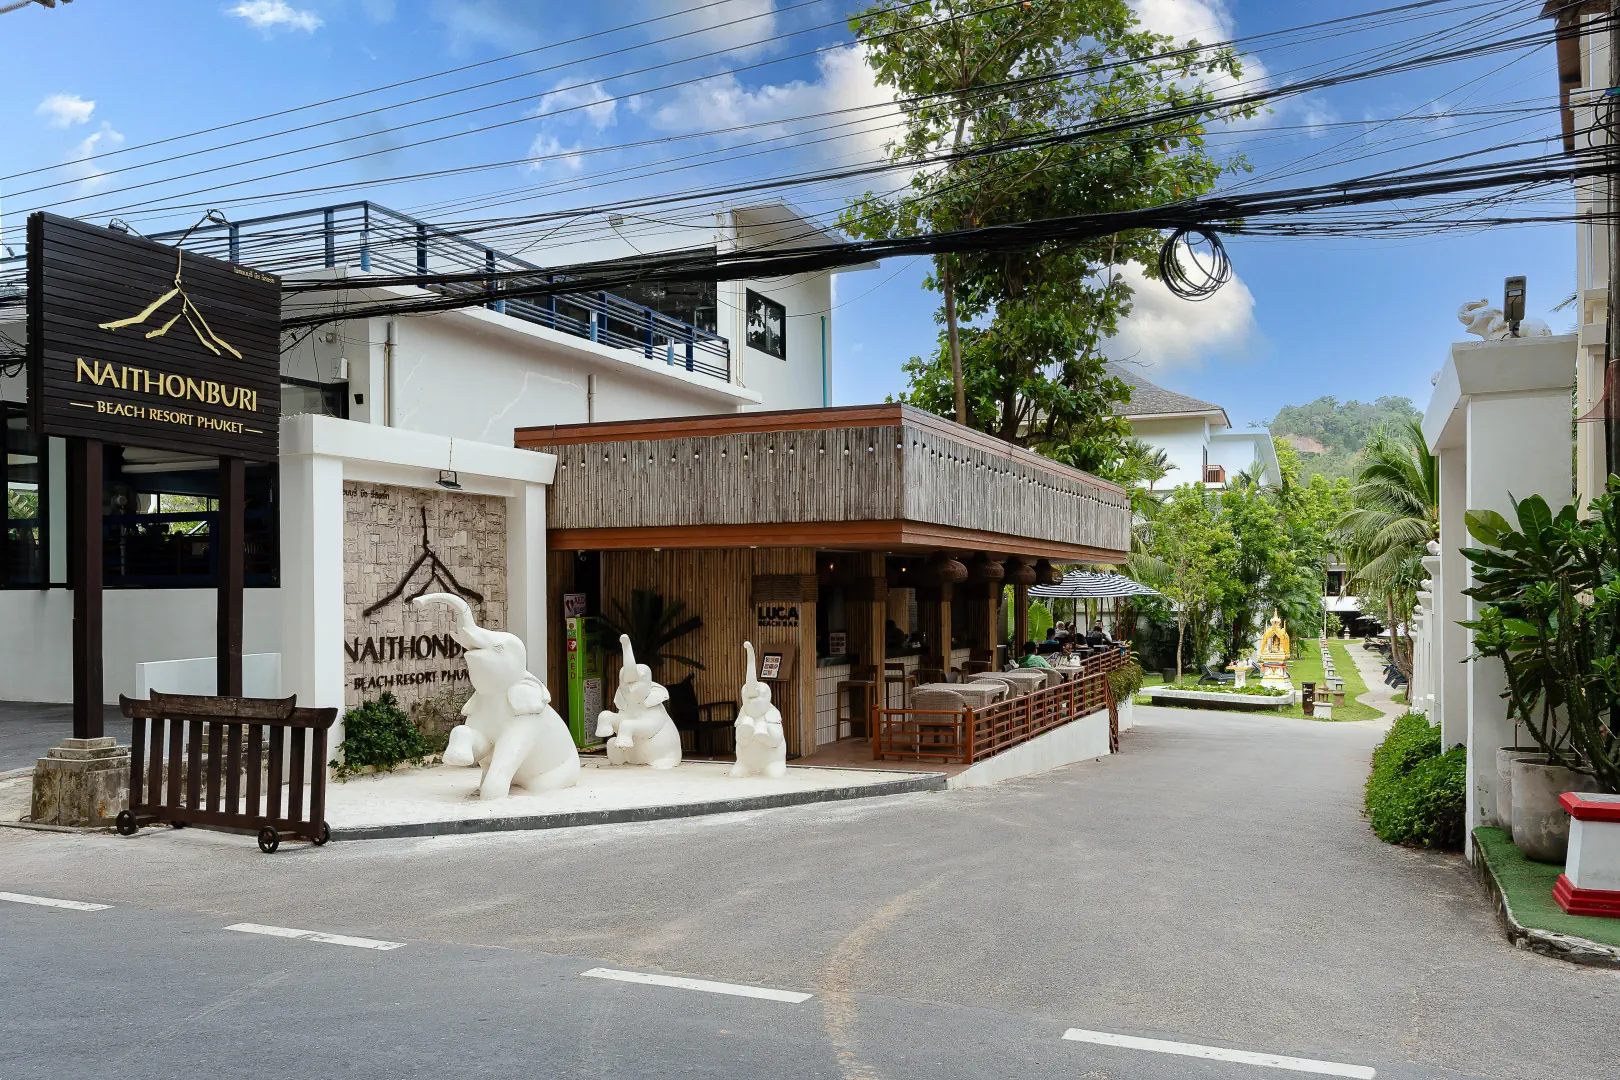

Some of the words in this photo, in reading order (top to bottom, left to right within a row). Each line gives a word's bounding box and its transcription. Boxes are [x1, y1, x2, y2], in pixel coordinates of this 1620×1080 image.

[76, 357, 257, 411] NAITHONBURI
[96, 401, 145, 419] BEACH
[149, 408, 194, 426] RESORT
[198, 416, 243, 434] PHUKET
[758, 606, 799, 620] LUCA
[782, 620, 799, 628] BAR
[344, 633, 468, 663] NAITHONB
[569, 653, 577, 680] AED
[354, 674, 394, 691] BEACH
[395, 671, 437, 686] RESORT
